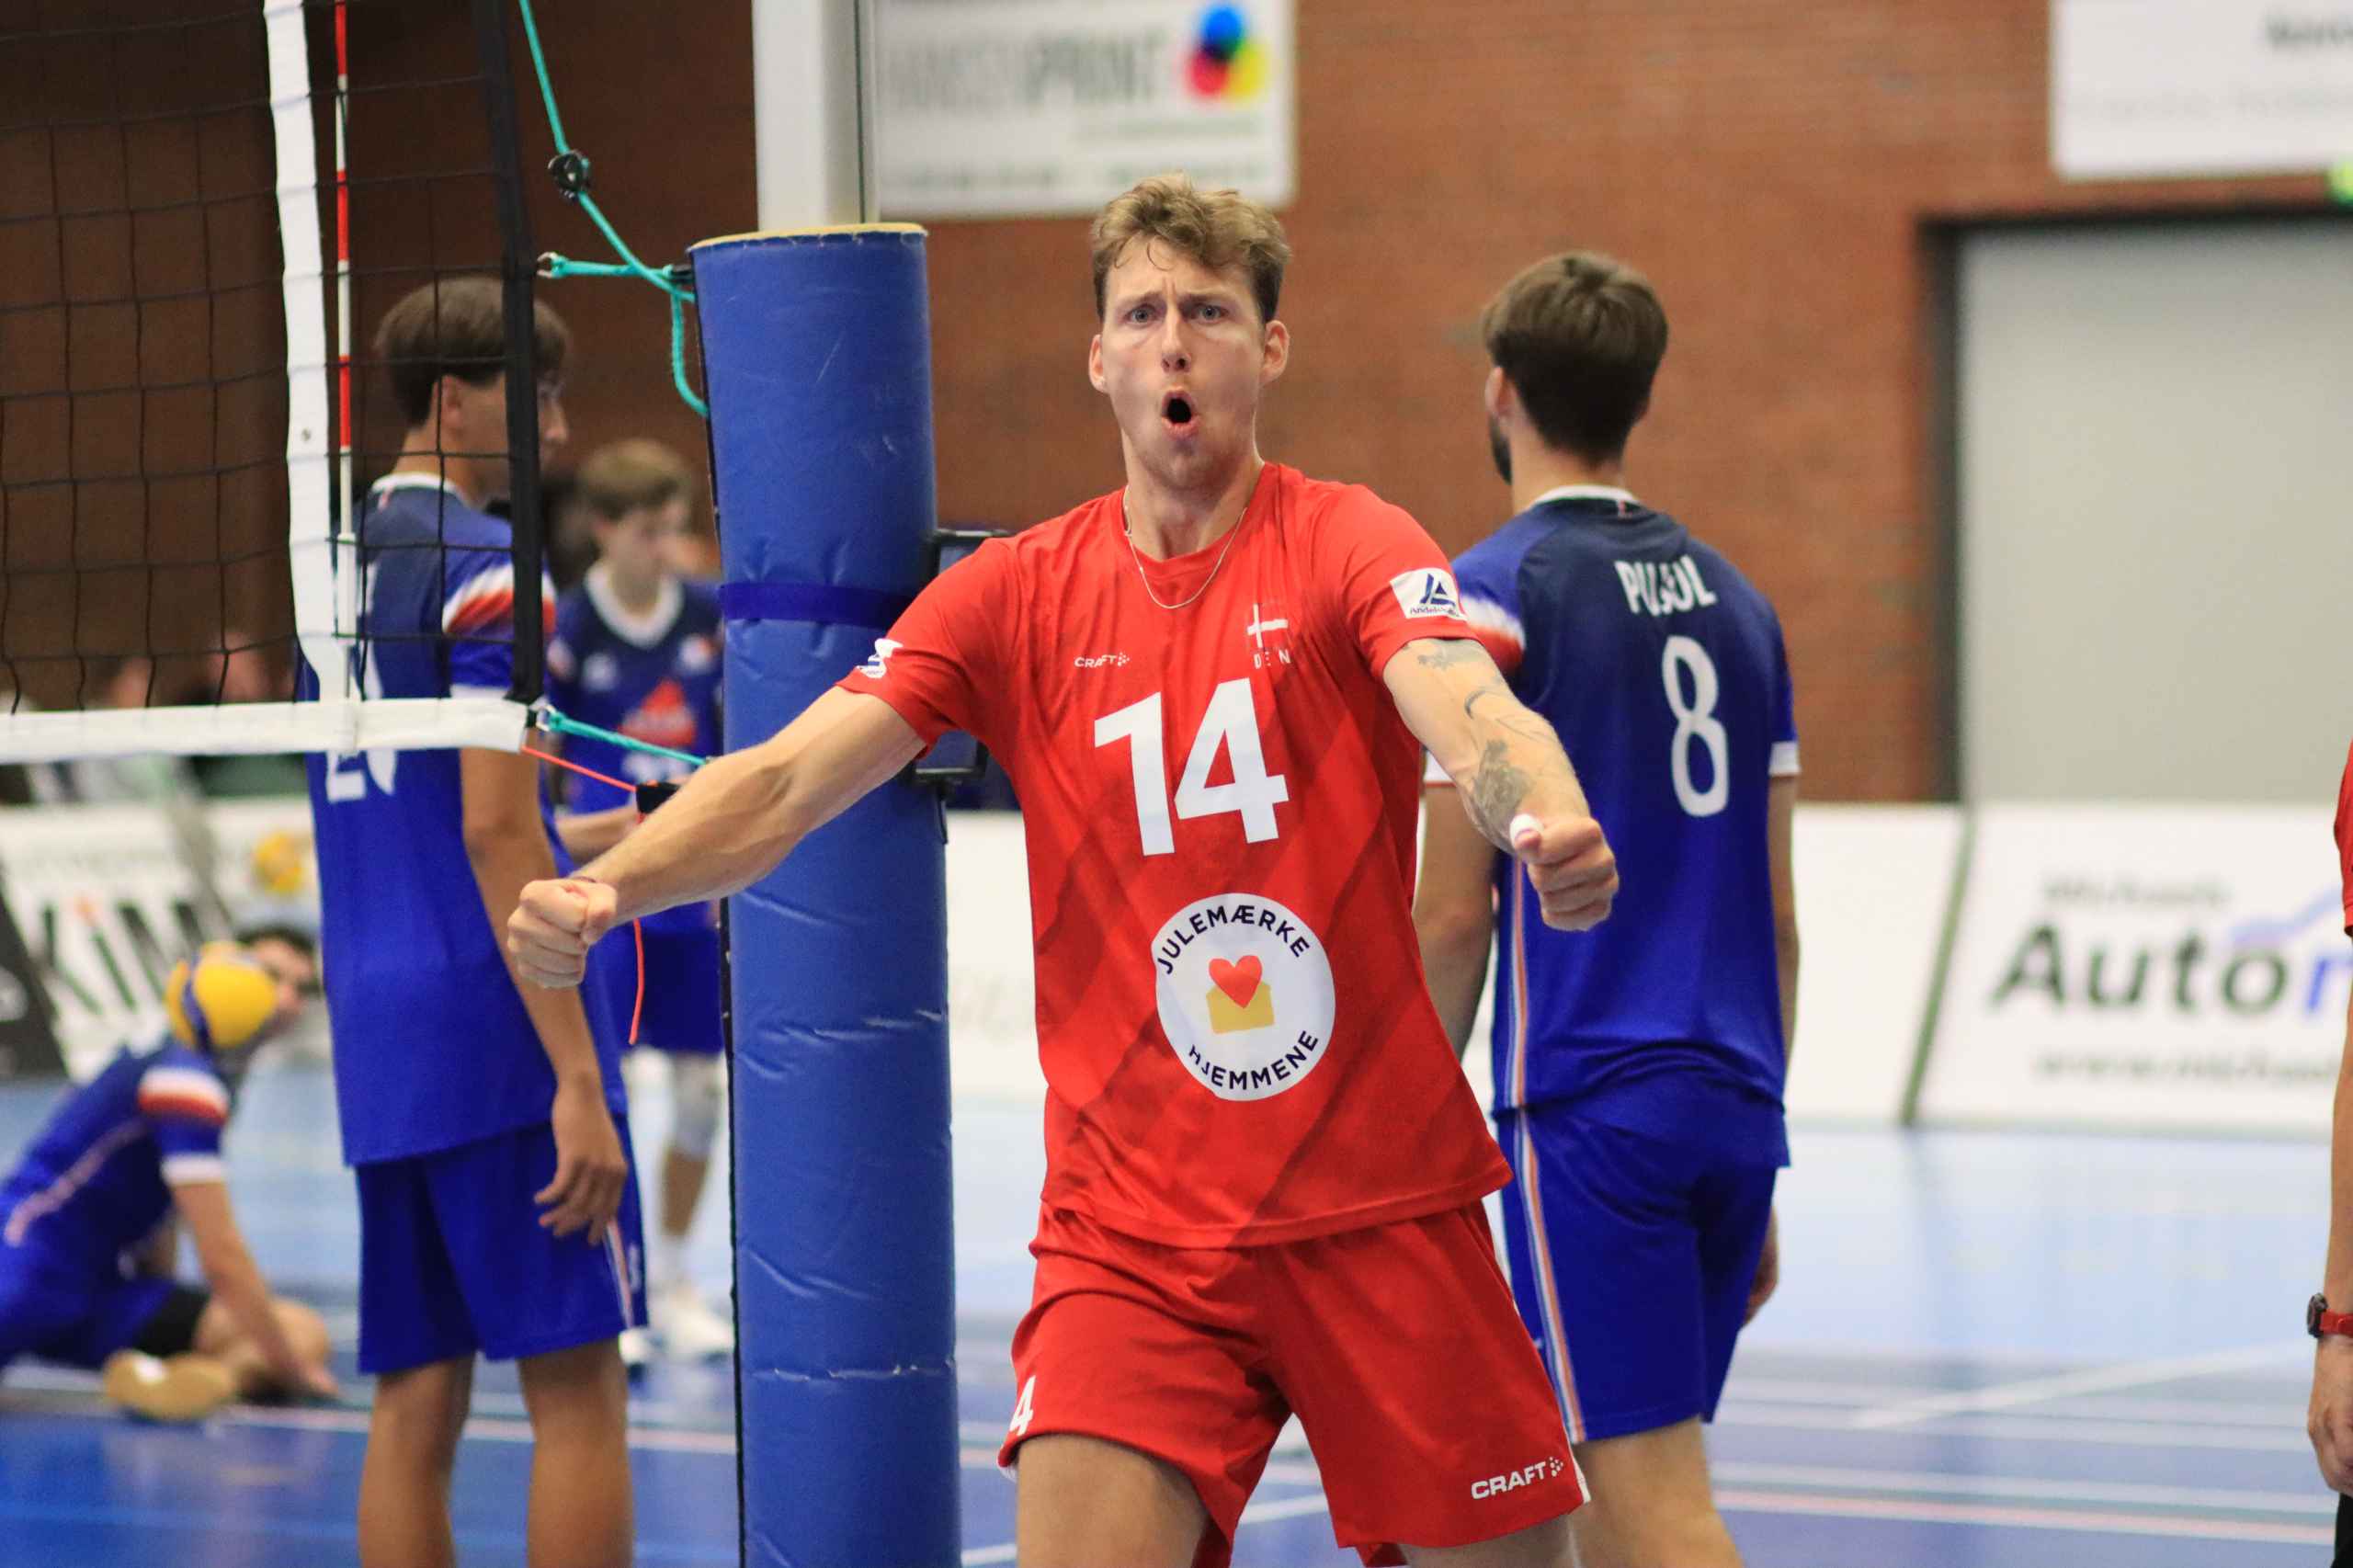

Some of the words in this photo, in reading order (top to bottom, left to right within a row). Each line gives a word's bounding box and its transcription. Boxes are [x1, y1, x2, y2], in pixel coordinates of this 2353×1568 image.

[1074, 653, 1117, 668] CRAFT
[1662, 635, 1729, 817] 8
[1094, 677, 1289, 857] 14
[1156, 904, 1310, 975] JULEMÆRKE
[1188, 1029, 1319, 1091] HJEMMENE
[1471, 1460, 1546, 1500] CRAFT
